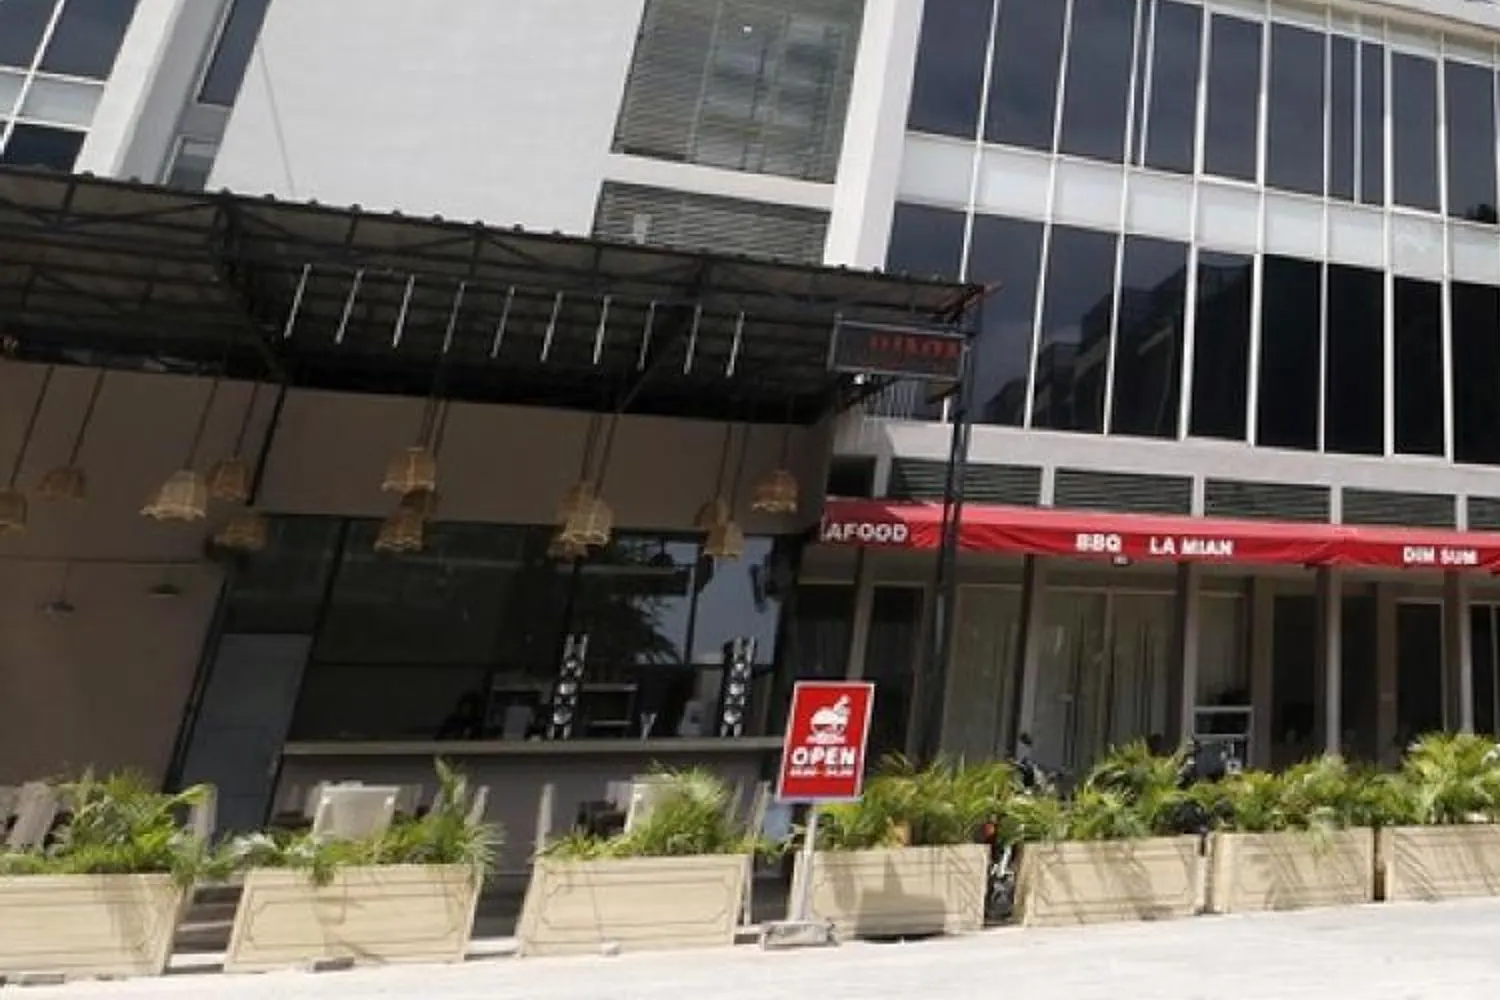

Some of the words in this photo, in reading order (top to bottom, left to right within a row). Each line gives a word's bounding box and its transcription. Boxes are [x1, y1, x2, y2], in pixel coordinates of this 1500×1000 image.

[821, 523, 908, 541] AFOOD
[1076, 533, 1122, 552] BBQ
[1151, 536, 1175, 555] LA
[1181, 538, 1234, 555] MIAN
[1403, 545, 1435, 563] DIM
[1441, 547, 1478, 565] SUM
[791, 746, 856, 765] OPEN
